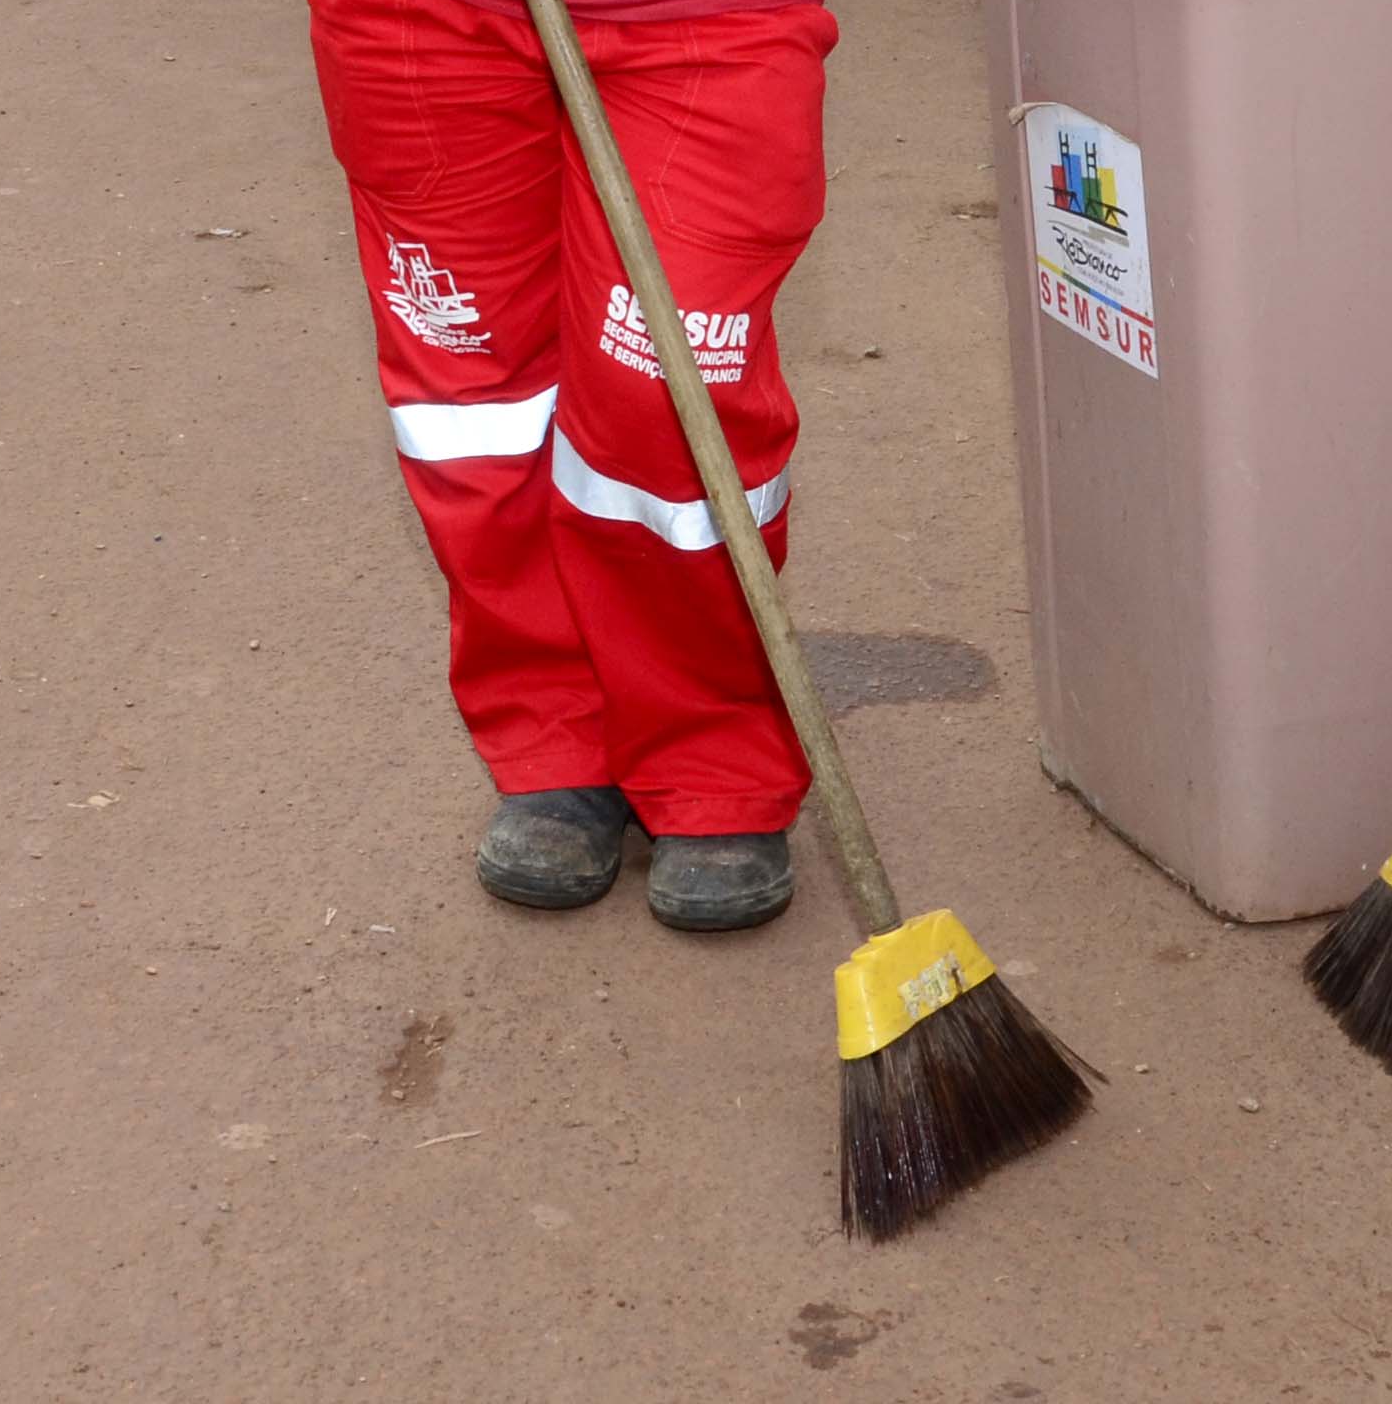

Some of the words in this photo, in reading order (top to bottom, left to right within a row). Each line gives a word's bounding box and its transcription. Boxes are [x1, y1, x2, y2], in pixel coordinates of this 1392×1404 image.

[607, 284, 751, 348] SESUR
[1040, 271, 1155, 368] SEMSUR
[599, 334, 615, 356] DE
[693, 349, 747, 365] UNICIPAL
